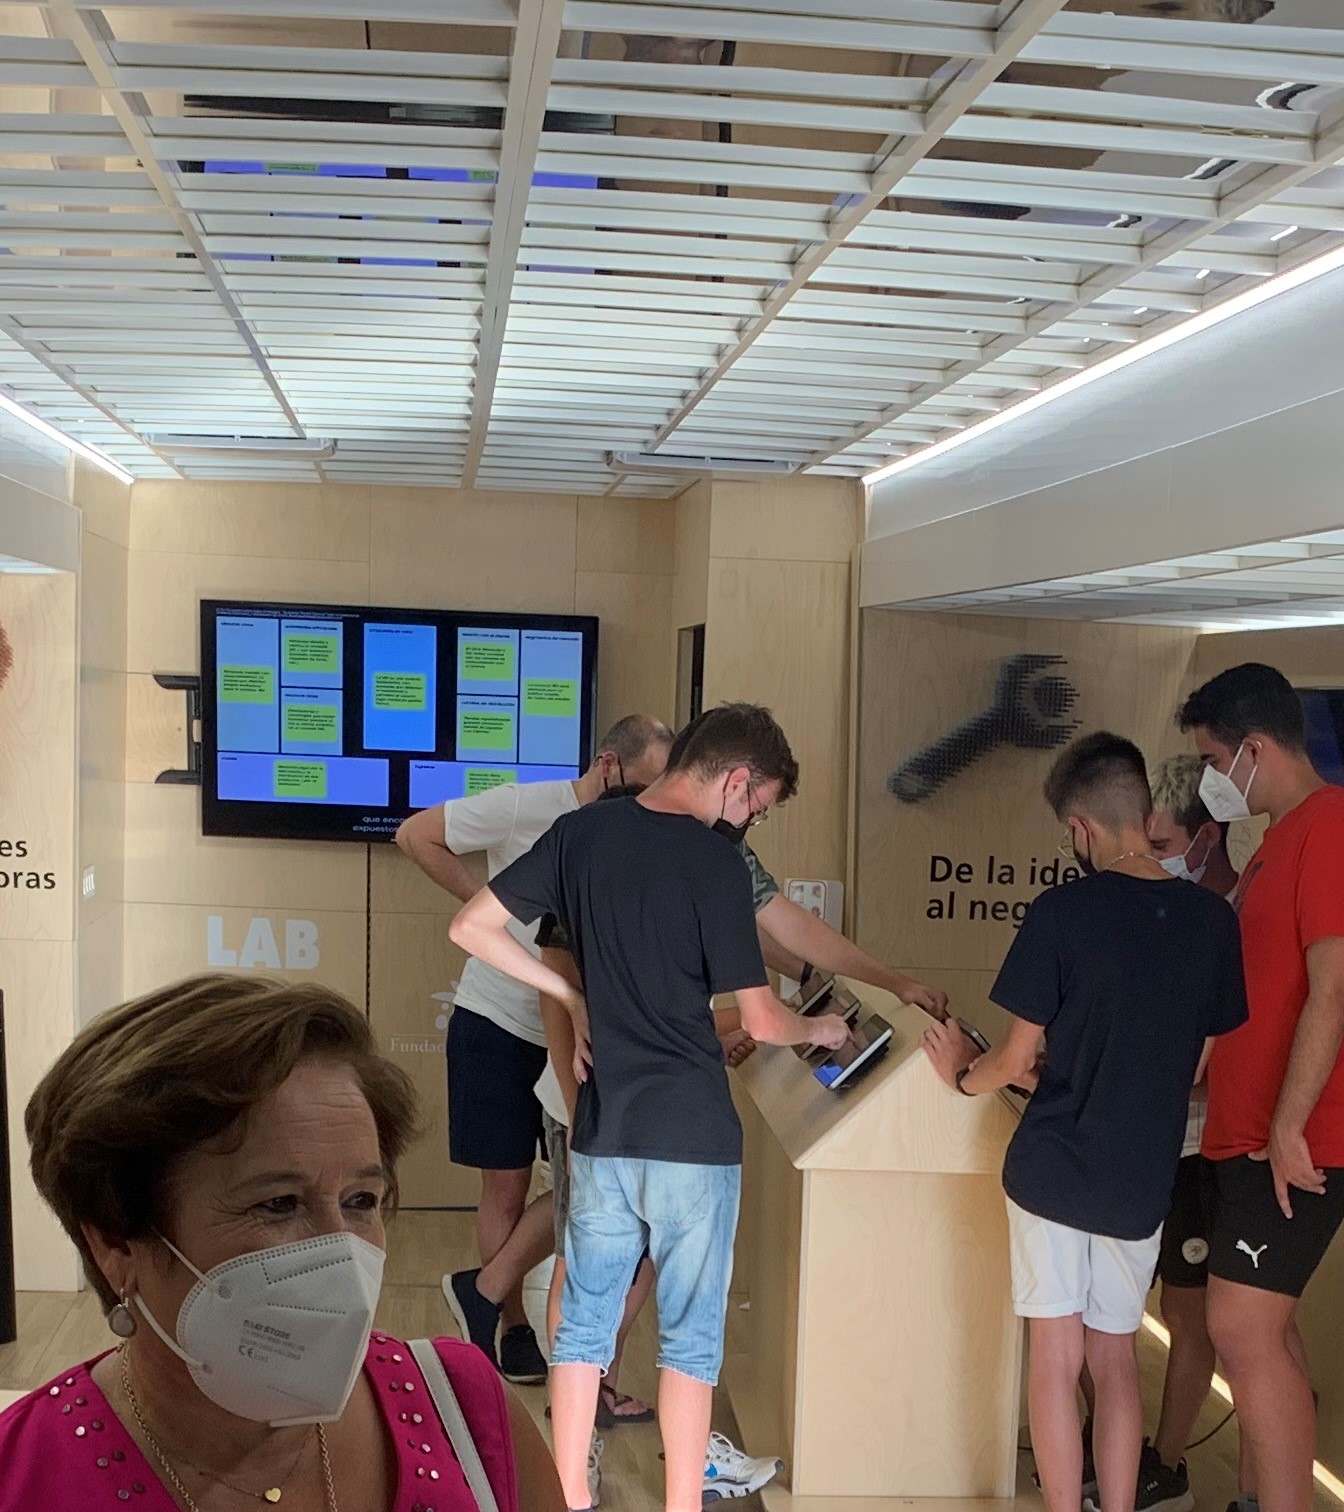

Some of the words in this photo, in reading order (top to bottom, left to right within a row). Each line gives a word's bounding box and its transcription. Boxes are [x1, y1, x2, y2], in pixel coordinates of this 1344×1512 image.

[930, 855, 974, 884] De
[987, 855, 1015, 886] la
[1029, 857, 1080, 887] ide
[926, 891, 955, 920] al
[969, 899, 1032, 930] neg
[207, 915, 320, 970] LAB
[390, 1037, 446, 1053] Fundac
